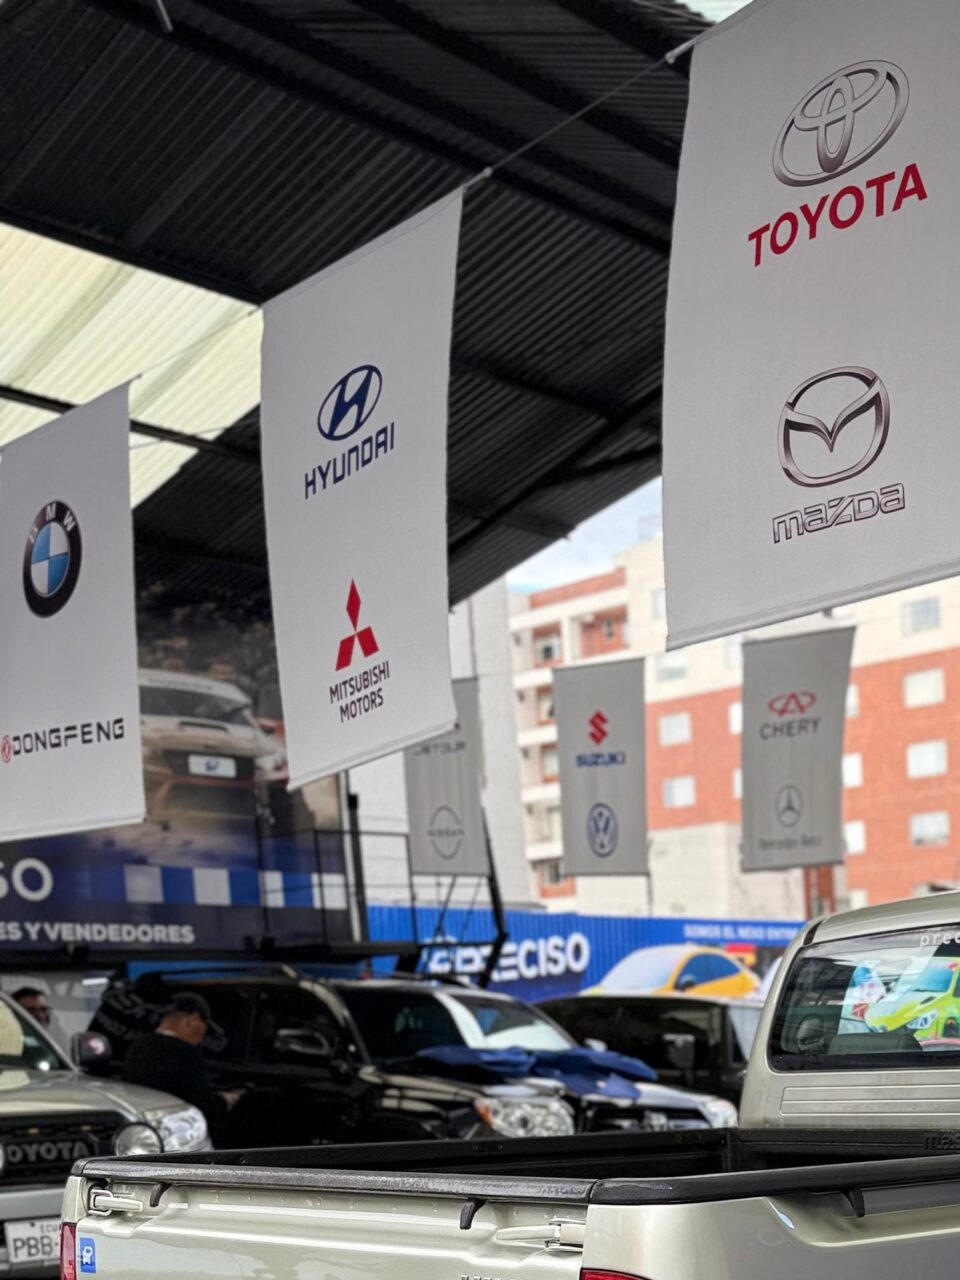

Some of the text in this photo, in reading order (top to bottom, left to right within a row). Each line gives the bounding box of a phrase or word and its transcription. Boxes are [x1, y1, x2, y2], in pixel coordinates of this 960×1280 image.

[747, 163, 928, 267] TOYOTA
[305, 421, 395, 500] HYUNDAI
[28, 502, 75, 543] BMW
[329, 660, 390, 704] MITSUBISHI
[340, 687, 384, 723] MOTORS
[13, 717, 125, 756] DONGFENG
[759, 717, 821, 741] CHERY
[576, 752, 625, 767] SUZUKI
[24, 922, 41, 941] Y
[44, 922, 195, 943] VENDEDORES
[455, 932, 590, 984] PECISO
[6, 1141, 90, 1164] OYOTA
